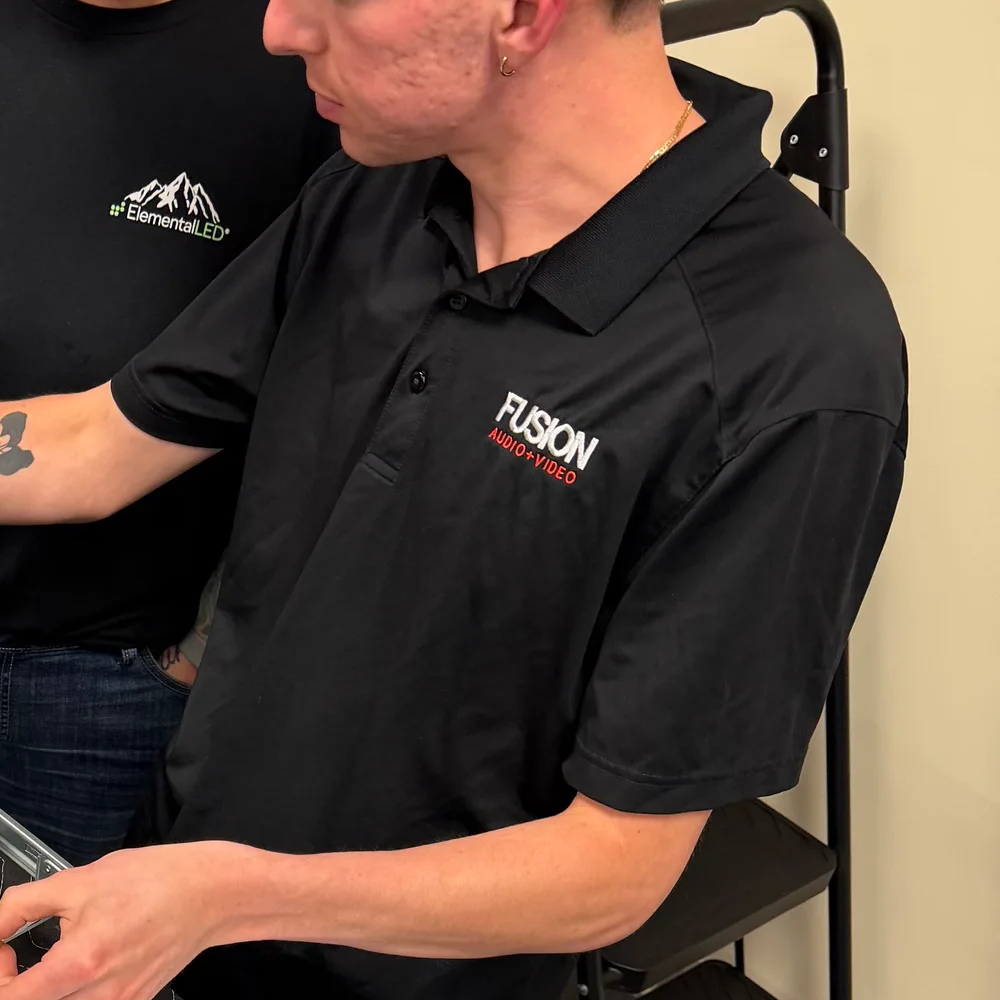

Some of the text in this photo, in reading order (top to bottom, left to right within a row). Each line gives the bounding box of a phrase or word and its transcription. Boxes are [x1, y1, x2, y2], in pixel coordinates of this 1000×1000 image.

[126, 203, 226, 242] ElementalLED
[488, 427, 578, 485] AUDIO+VIDEO
[493, 391, 599, 471] FUSION
